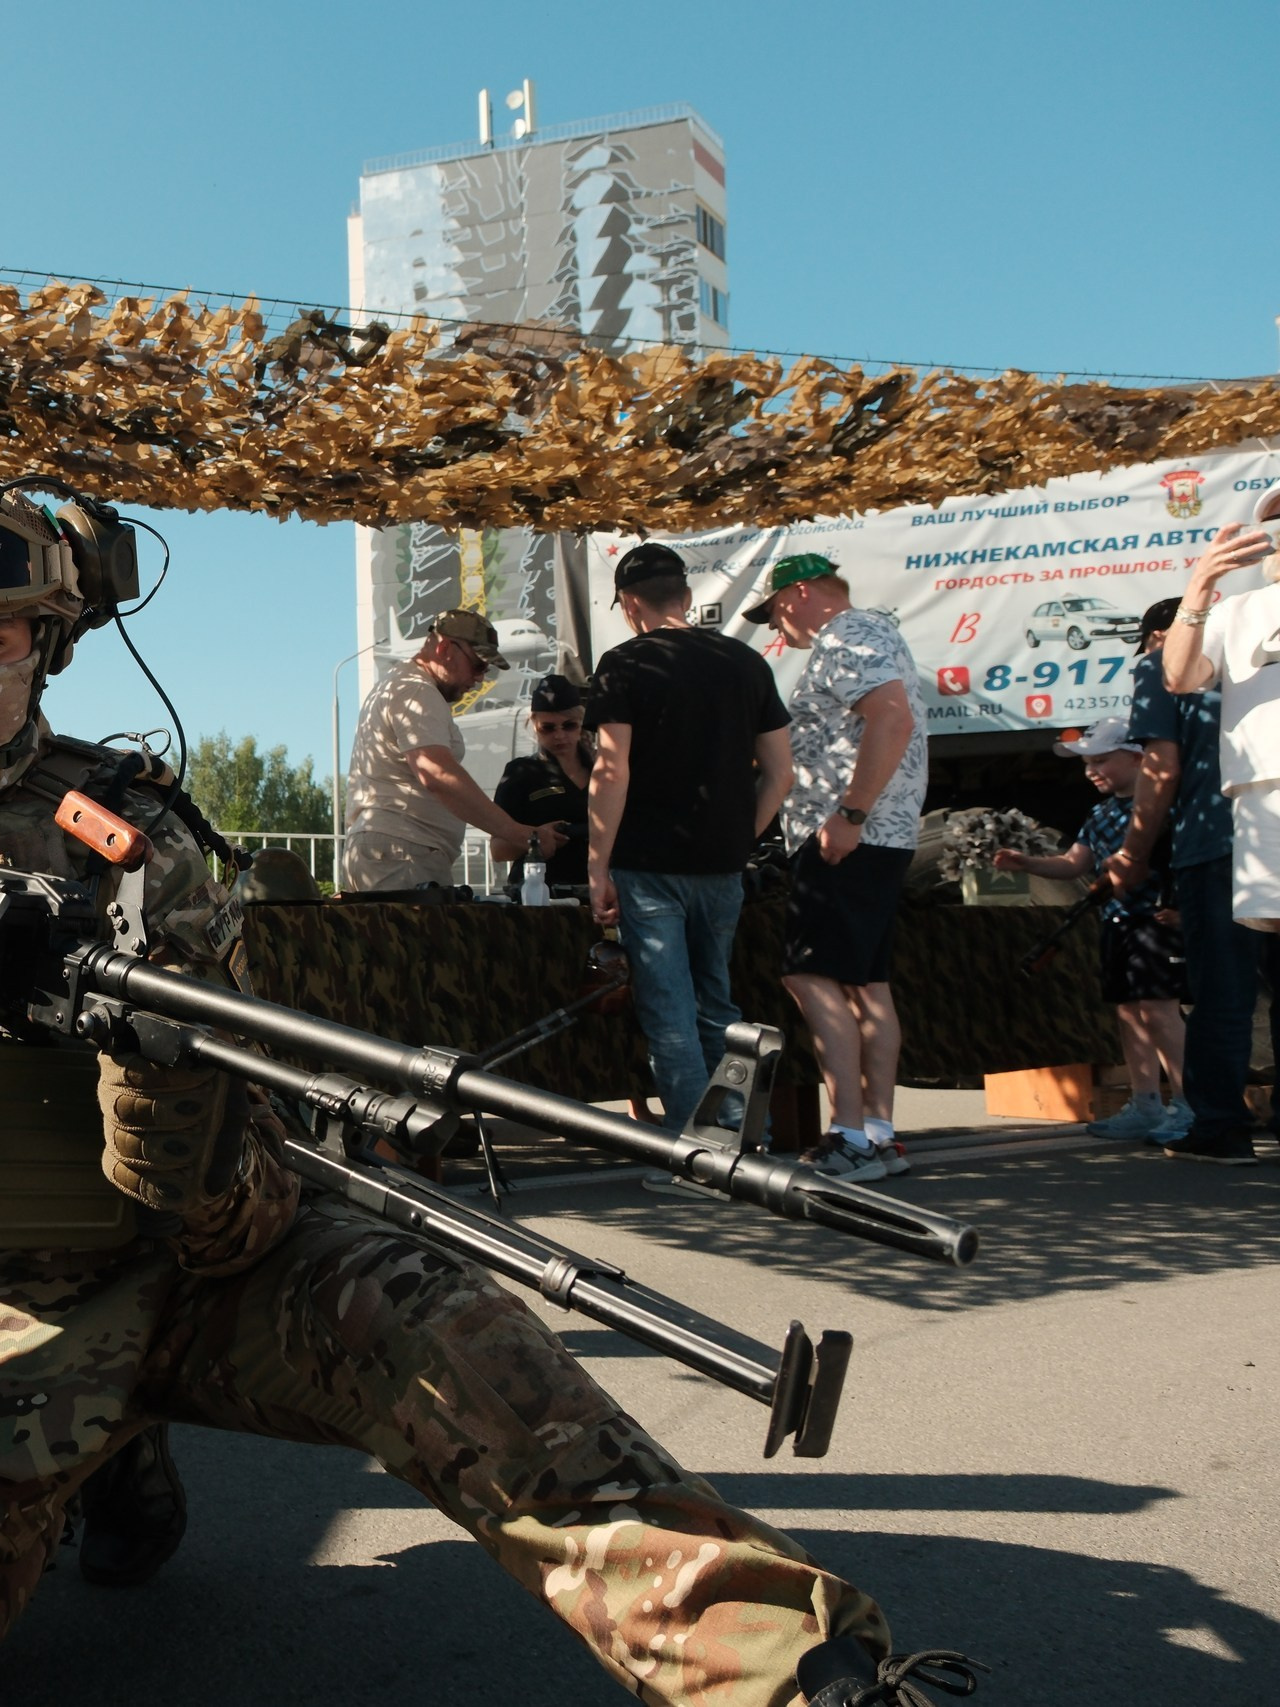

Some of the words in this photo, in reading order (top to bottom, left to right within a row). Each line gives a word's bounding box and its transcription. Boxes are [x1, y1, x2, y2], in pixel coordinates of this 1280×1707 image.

[1233, 476, 1280, 492] ОБУ
[911, 512, 956, 527] ВАШ
[960, 500, 1049, 522] ЛУЧШИЙ
[1054, 495, 1130, 513] ВЫБОР
[905, 534, 1140, 570] НИЖНЕКАМСКАЯ
[935, 571, 1035, 591] ГОРДОСТЬ
[1040, 569, 1064, 581] ЗА
[1069, 559, 1177, 579] ПРОШЛОЕ,
[1063, 694, 1133, 710] 423570
